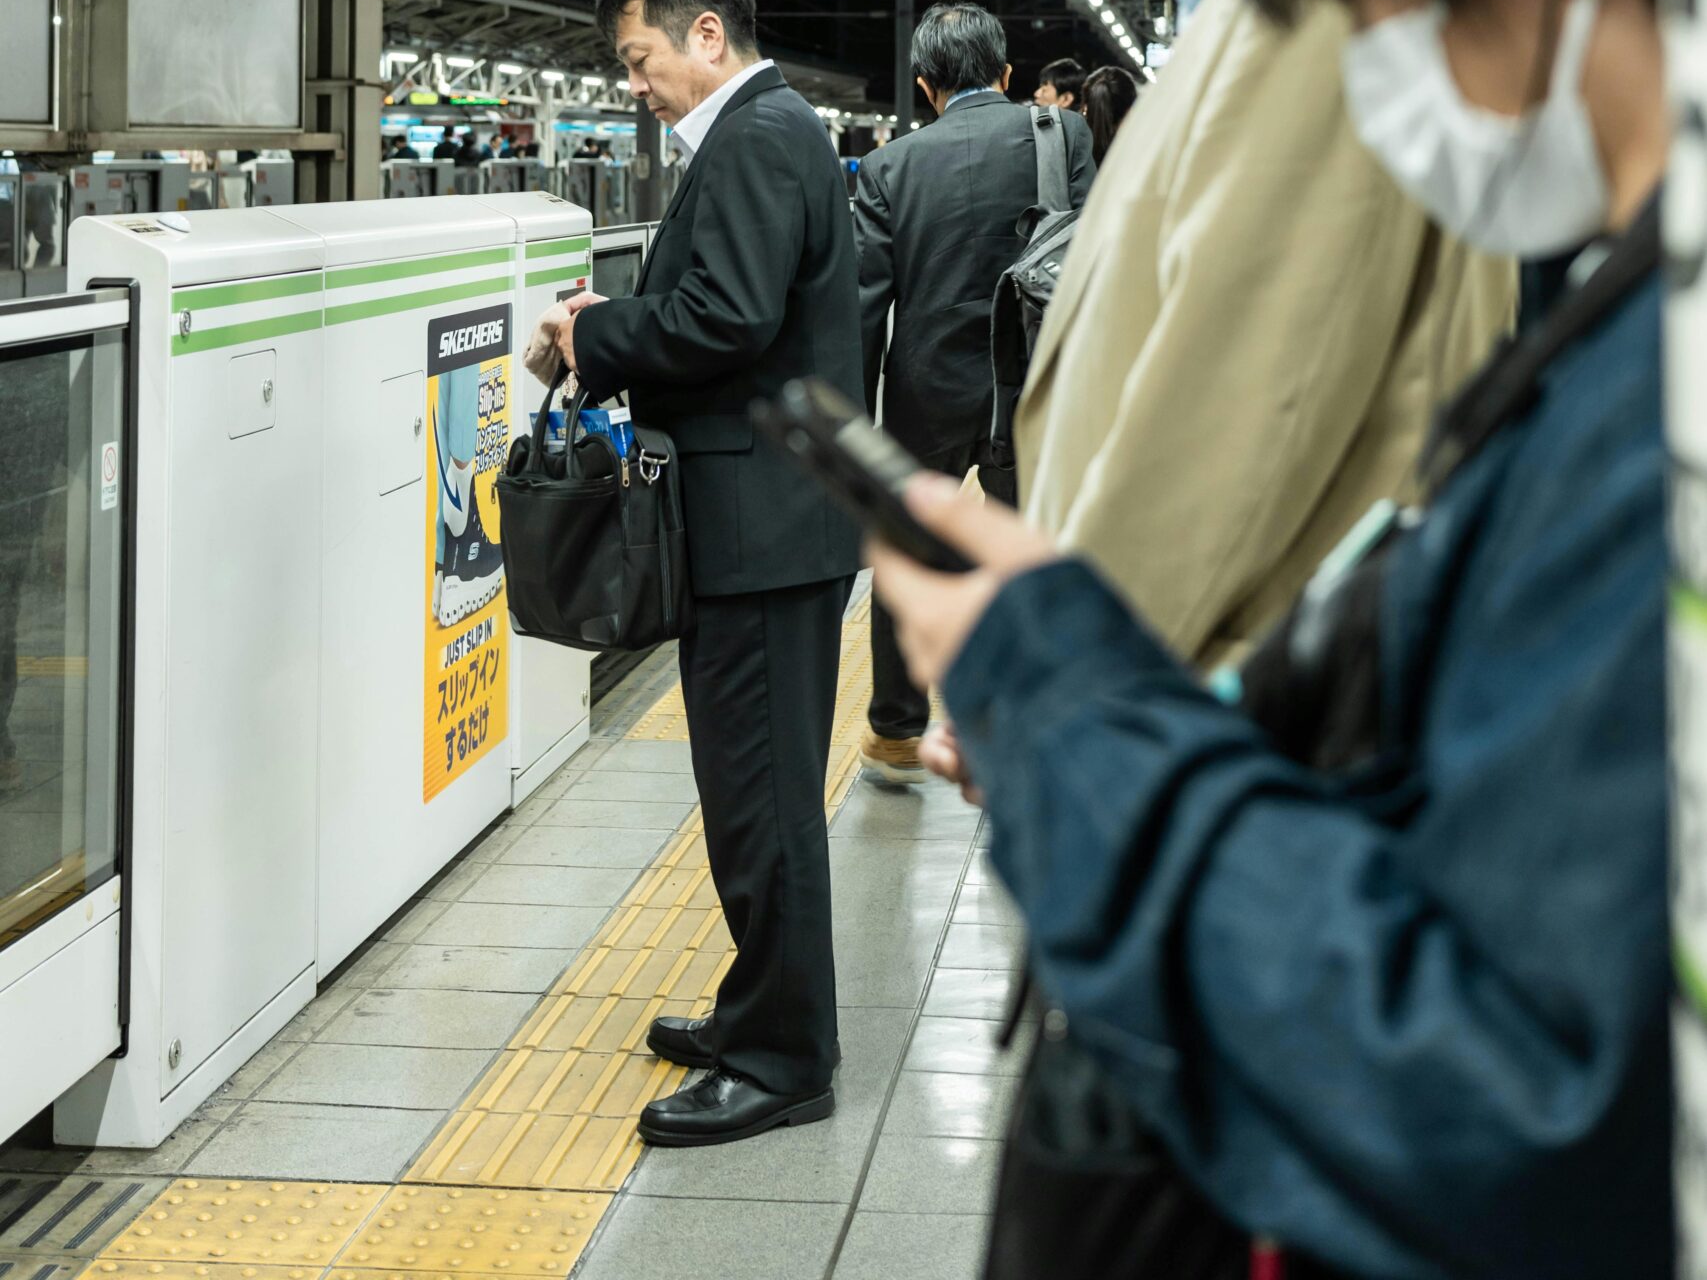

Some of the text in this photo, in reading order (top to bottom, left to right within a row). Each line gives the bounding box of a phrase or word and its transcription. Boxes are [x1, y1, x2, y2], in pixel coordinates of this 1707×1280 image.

[438, 319, 504, 359] SKECHERS
[478, 380, 506, 420] Slip-ins
[475, 419, 509, 455] ハンズフリー
[444, 616, 493, 668] JUST SLIP IN
[437, 647, 500, 724] スリップイン
[445, 699, 490, 773] するだけ
